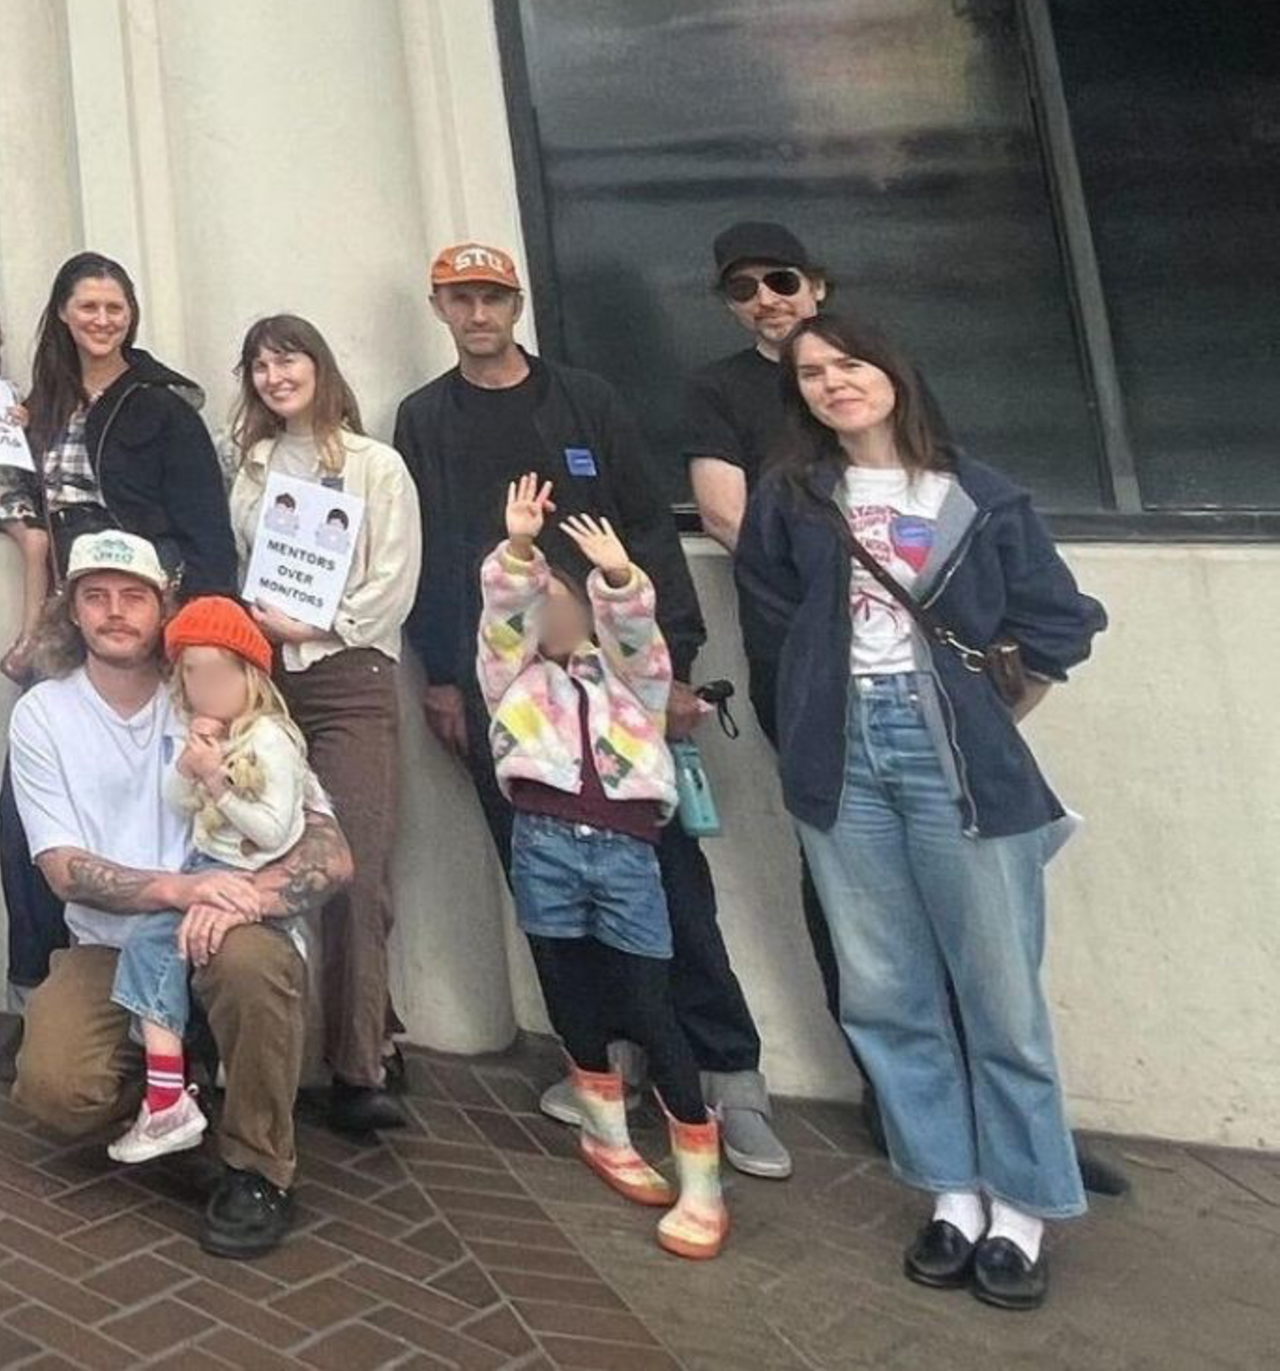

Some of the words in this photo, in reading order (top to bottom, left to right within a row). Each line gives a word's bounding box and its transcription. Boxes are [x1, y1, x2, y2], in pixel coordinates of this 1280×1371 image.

[266, 539, 337, 572] MENTORS
[277, 564, 315, 585] OVER
[258, 576, 325, 609] MONITORS
